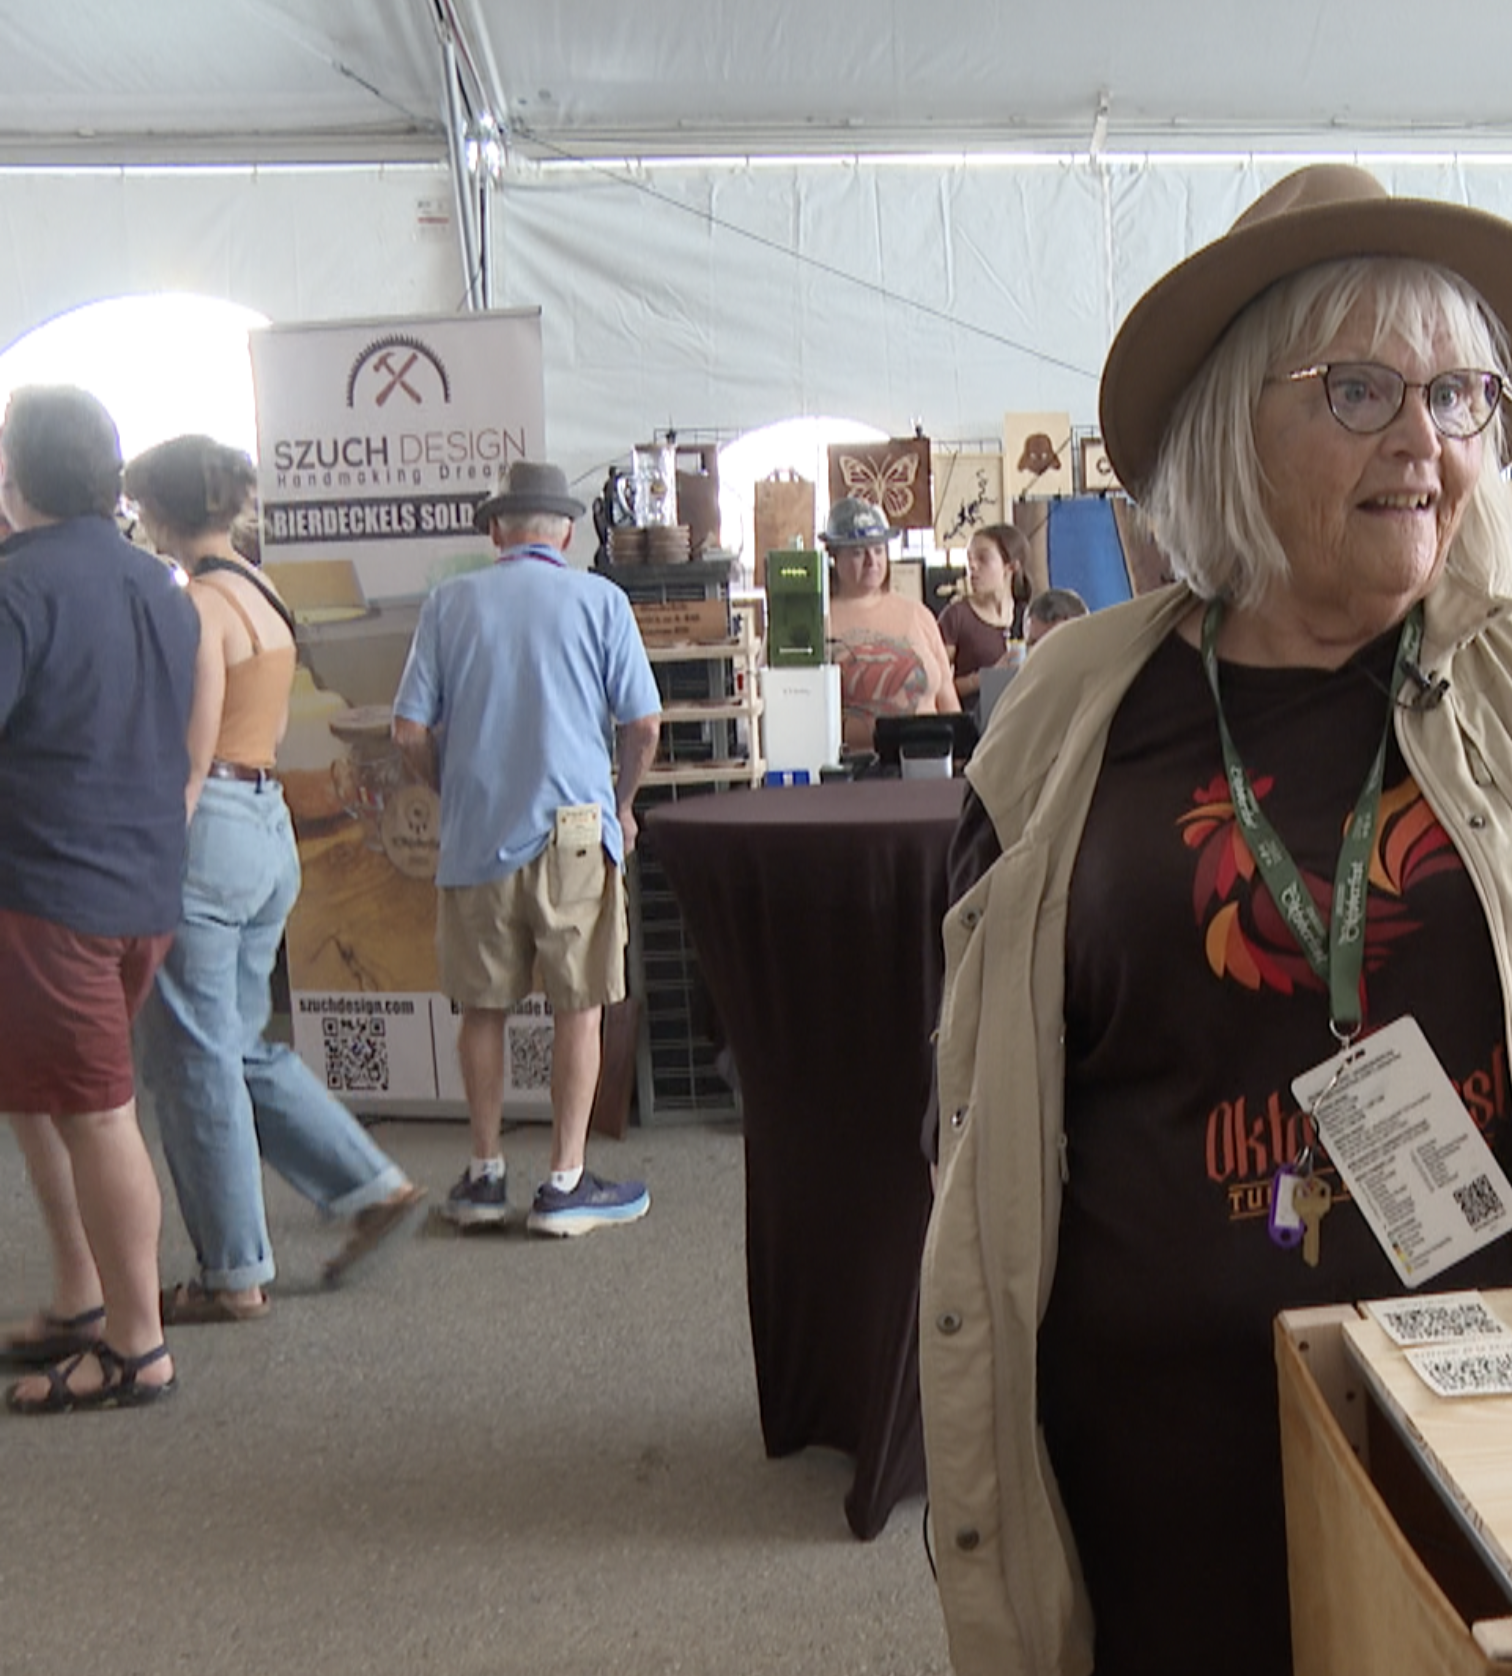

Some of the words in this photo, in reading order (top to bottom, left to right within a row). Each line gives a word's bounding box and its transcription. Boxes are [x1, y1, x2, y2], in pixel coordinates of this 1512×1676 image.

[274, 435, 389, 471] SZUCH
[400, 427, 526, 465] DESIGN
[277, 466, 422, 489] Handmaking
[272, 505, 416, 537] BIERDECKELS
[420, 502, 474, 531] SOLD
